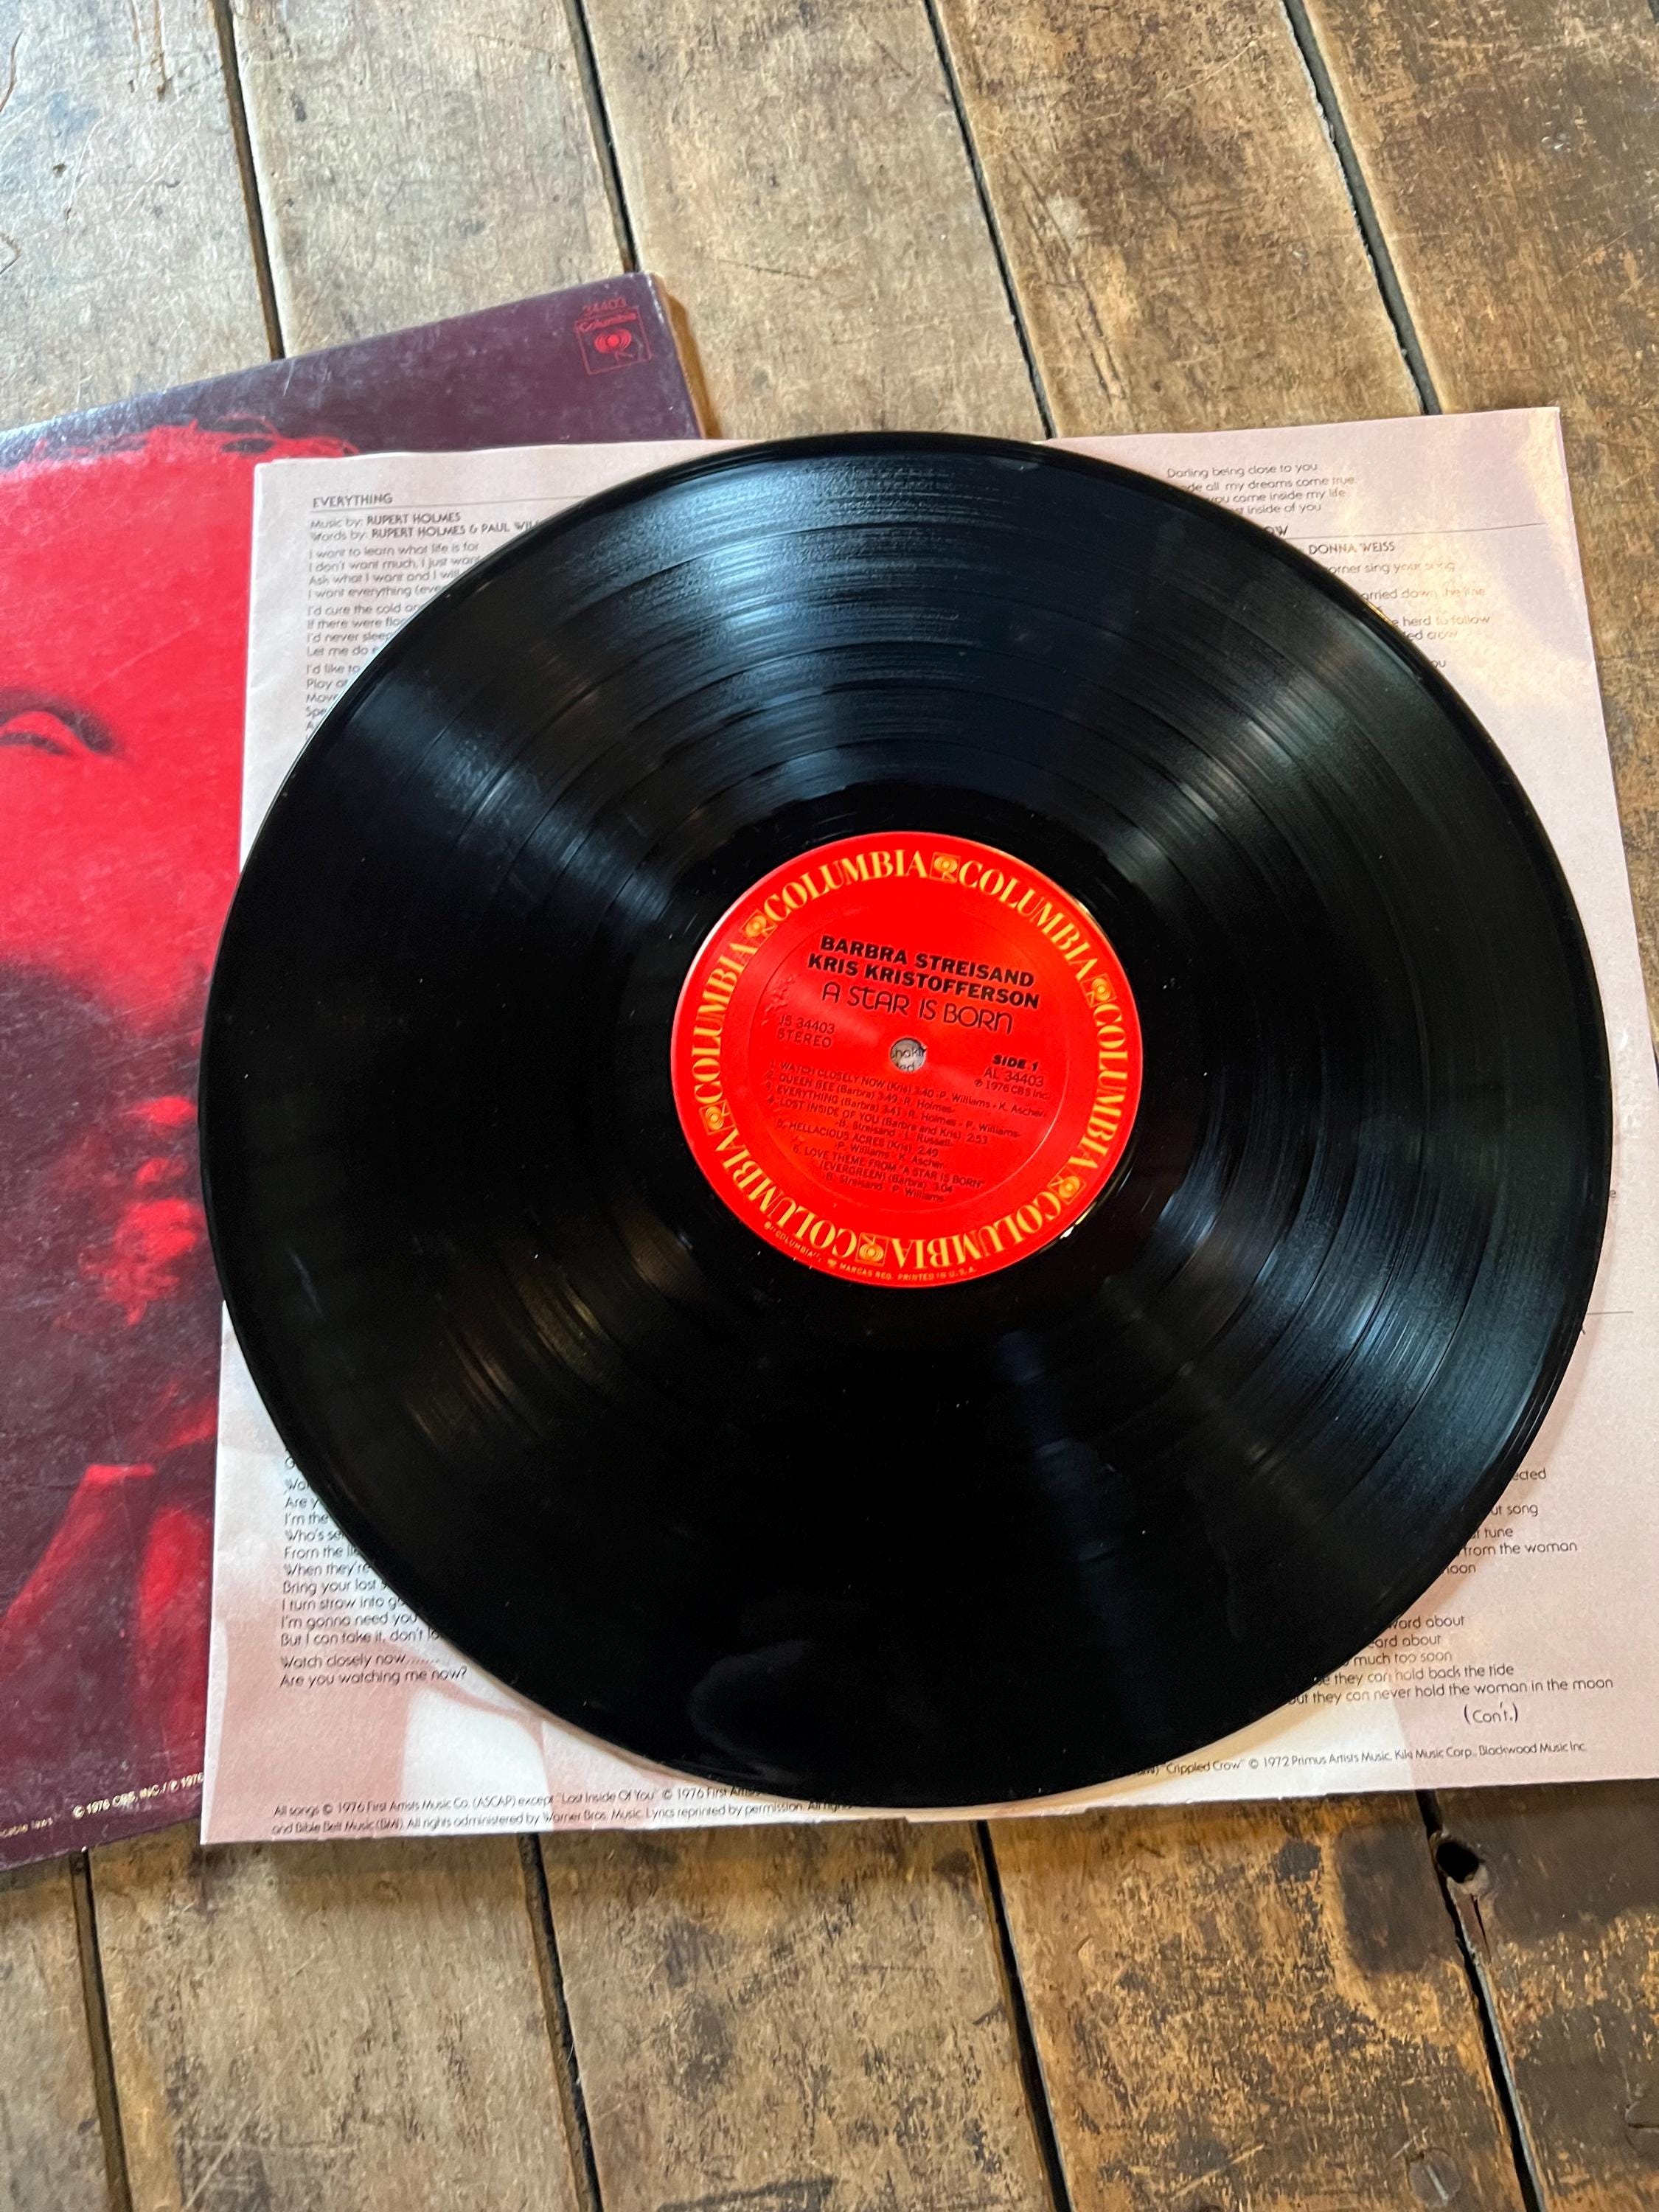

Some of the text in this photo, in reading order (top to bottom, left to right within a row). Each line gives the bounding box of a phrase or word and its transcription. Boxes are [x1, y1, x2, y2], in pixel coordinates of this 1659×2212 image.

[1167, 463, 1318, 479] Darling being close to you
[1206, 478, 1329, 492] all my dreams come
[313, 493, 393, 508] EVERYTHING
[1232, 490, 1302, 503] come inside
[1248, 502, 1322, 514] inside of you
[367, 512, 461, 525] RUPERT HOLMES
[372, 523, 510, 538] RUPERT HOLMES PAUL
[1308, 541, 1396, 555] DONNA WEISS
[1365, 562, 1390, 574] sing
[348, 586, 411, 598] everything
[377, 604, 401, 613] cold
[764, 849, 928, 921] COLUMBIA
[959, 860, 1098, 981] COLUMBIA
[820, 935, 1034, 988] BARBRA STREISAND
[807, 953, 1040, 1009] KRIS KRISTOFFERSON
[822, 981, 841, 1004] A
[919, 998, 939, 1020] IS
[692, 943, 758, 1104] COLUMBIA
[796, 1016, 835, 1034] 34403
[777, 1027, 832, 1048] STEREO
[992, 1054, 1039, 1071] SIDE 1
[779, 1073, 812, 1088] QUEEN
[837, 1084, 875, 1099] (Barbra)
[780, 1061, 990, 1108] WATCH CLOSELY NOW Williams
[984, 1068, 1044, 1088] AL 34403
[986, 1081, 1031, 1097] 1976 CBS
[1068, 1004, 1127, 1169] COLUMBIA
[776, 1085, 838, 1105] EVERYTHING
[779, 1098, 880, 1124] LOST INSIDE OF YOU
[789, 1122, 849, 1141] HELLACIOUS
[804, 1147, 829, 1160] LOVE
[714, 1127, 857, 1258] COLUMBIA
[891, 1191, 1061, 1269] COLUMBIA
[285, 1497, 307, 1508] Are
[1507, 1503, 1539, 1517] song
[285, 1512, 305, 1525] I'm
[285, 1528, 324, 1542] Who's
[1484, 1527, 1514, 1539] tune
[284, 1545, 342, 1559] From the
[1463, 1541, 1577, 1557] from the woman
[283, 1564, 322, 1576] When
[283, 1581, 349, 1596] Bring your
[290, 1596, 384, 1610] turn straw into
[281, 1615, 302, 1628] I'm
[307, 1616, 350, 1632] gonna
[355, 1613, 388, 1625] need
[1425, 1615, 1464, 1628] about
[281, 1628, 422, 1646] But can take don't
[1402, 1635, 1441, 1646] about
[282, 1653, 372, 1669] Watch closely
[1354, 1651, 1453, 1666] much too soon
[280, 1666, 467, 1687] Are you watching me now?
[1335, 1672, 1363, 1686] they
[1428, 1666, 1461, 1679] back
[1464, 1665, 1485, 1677] the
[1489, 1663, 1514, 1676] tide
[1312, 1678, 1613, 1705] they can never hold the woman in the moon
[1264, 1756, 1290, 1767] 1972
[1292, 1754, 1326, 1766] Primus
[1329, 1753, 1359, 1764] Artists
[1415, 1747, 1443, 1759] Music
[1478, 1744, 1537, 1756] Blackwood
[1540, 1742, 1568, 1753] Music
[678, 1787, 704, 1799] 1976
[453, 1812, 524, 1826] administered
[543, 1810, 580, 1823] Warner
[678, 1804, 725, 1818] reprinted
[728, 1804, 742, 1817] by
